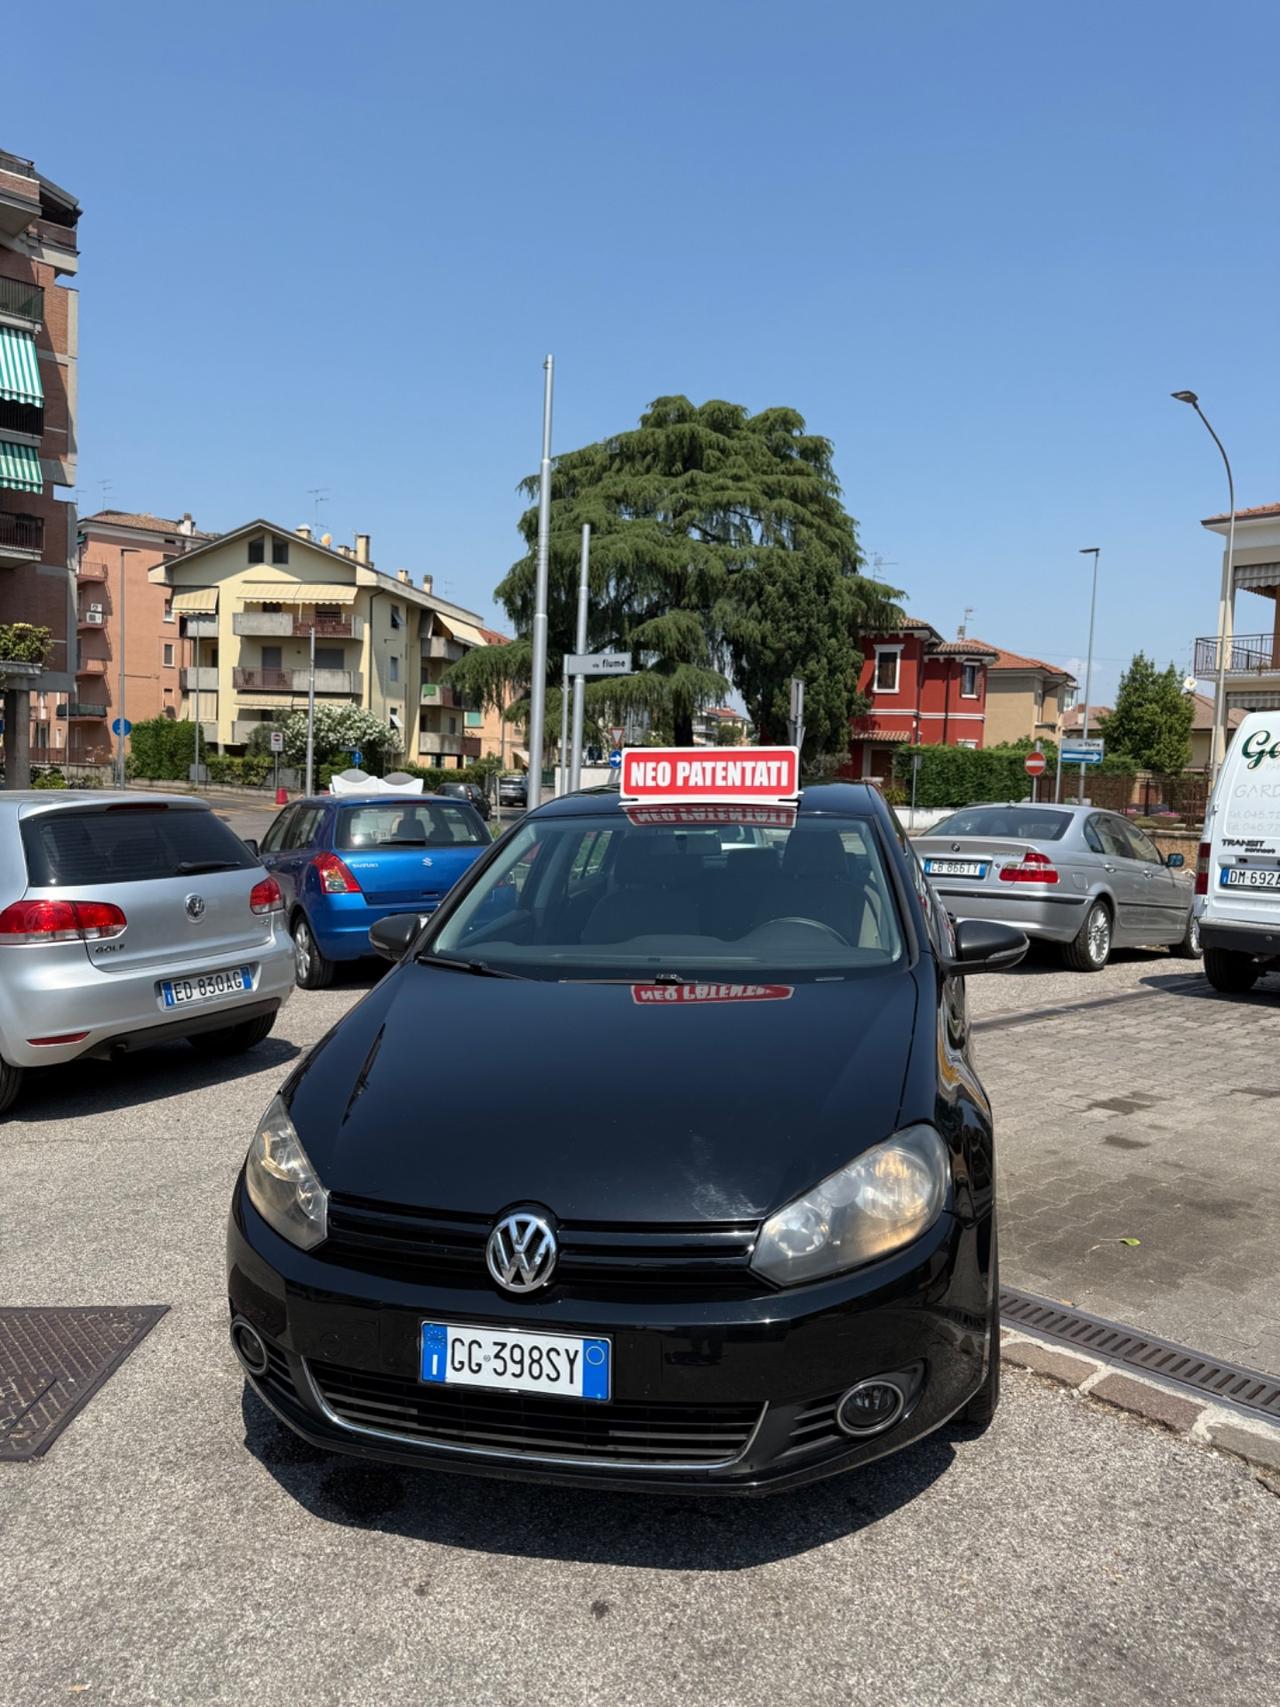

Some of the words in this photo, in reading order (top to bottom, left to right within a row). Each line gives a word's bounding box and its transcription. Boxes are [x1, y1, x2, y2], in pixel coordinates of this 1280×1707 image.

[630, 761, 672, 787] NEO
[676, 760, 789, 787] PATENTATI
[1221, 839, 1265, 847] TRANSIT
[1230, 870, 1246, 883] DM
[174, 983, 193, 1002] ED
[197, 971, 242, 997] 830AG
[451, 1337, 482, 1374] GG
[492, 1341, 580, 1385] 398SY
